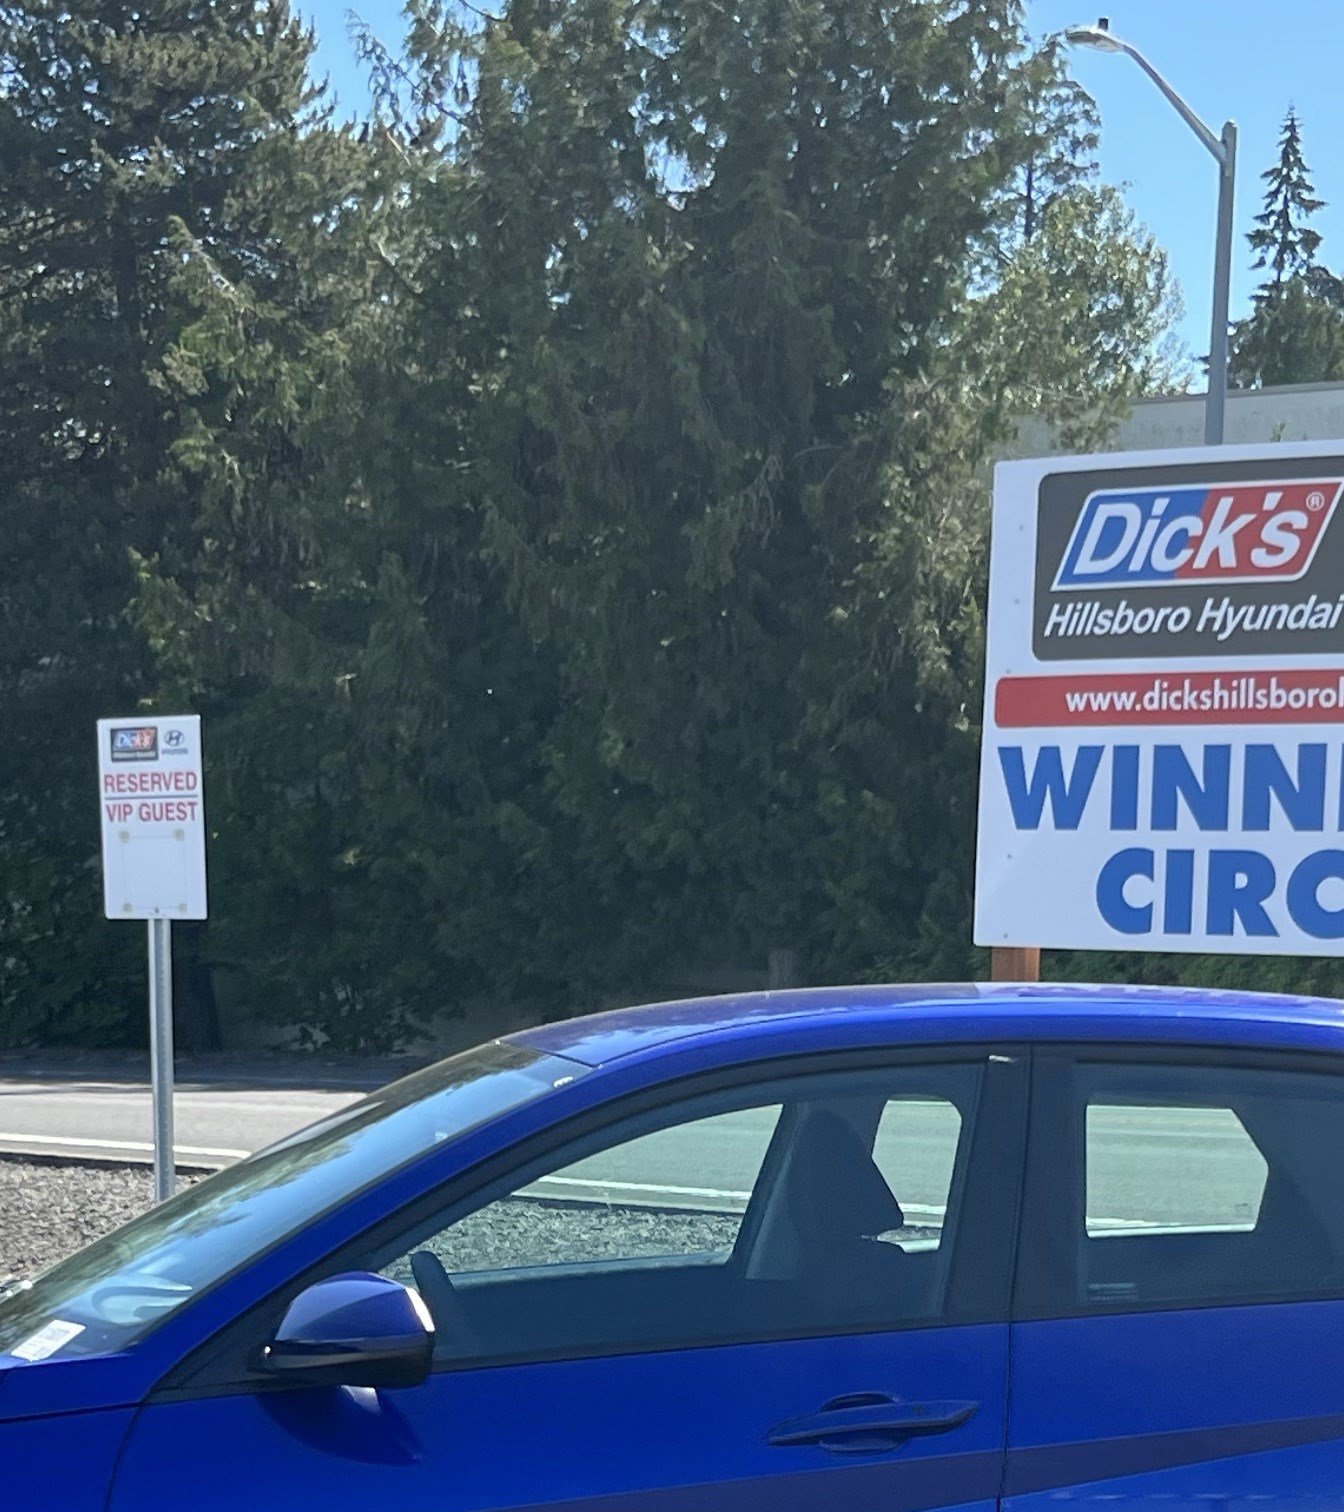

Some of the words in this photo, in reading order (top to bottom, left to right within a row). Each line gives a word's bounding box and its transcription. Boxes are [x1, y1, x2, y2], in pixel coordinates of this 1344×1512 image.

[1072, 491, 1309, 575] Dick's
[1043, 600, 1192, 638] Hillsboro
[105, 772, 197, 792] RESERVED
[107, 804, 133, 822] VIP
[139, 802, 197, 821] GUEST
